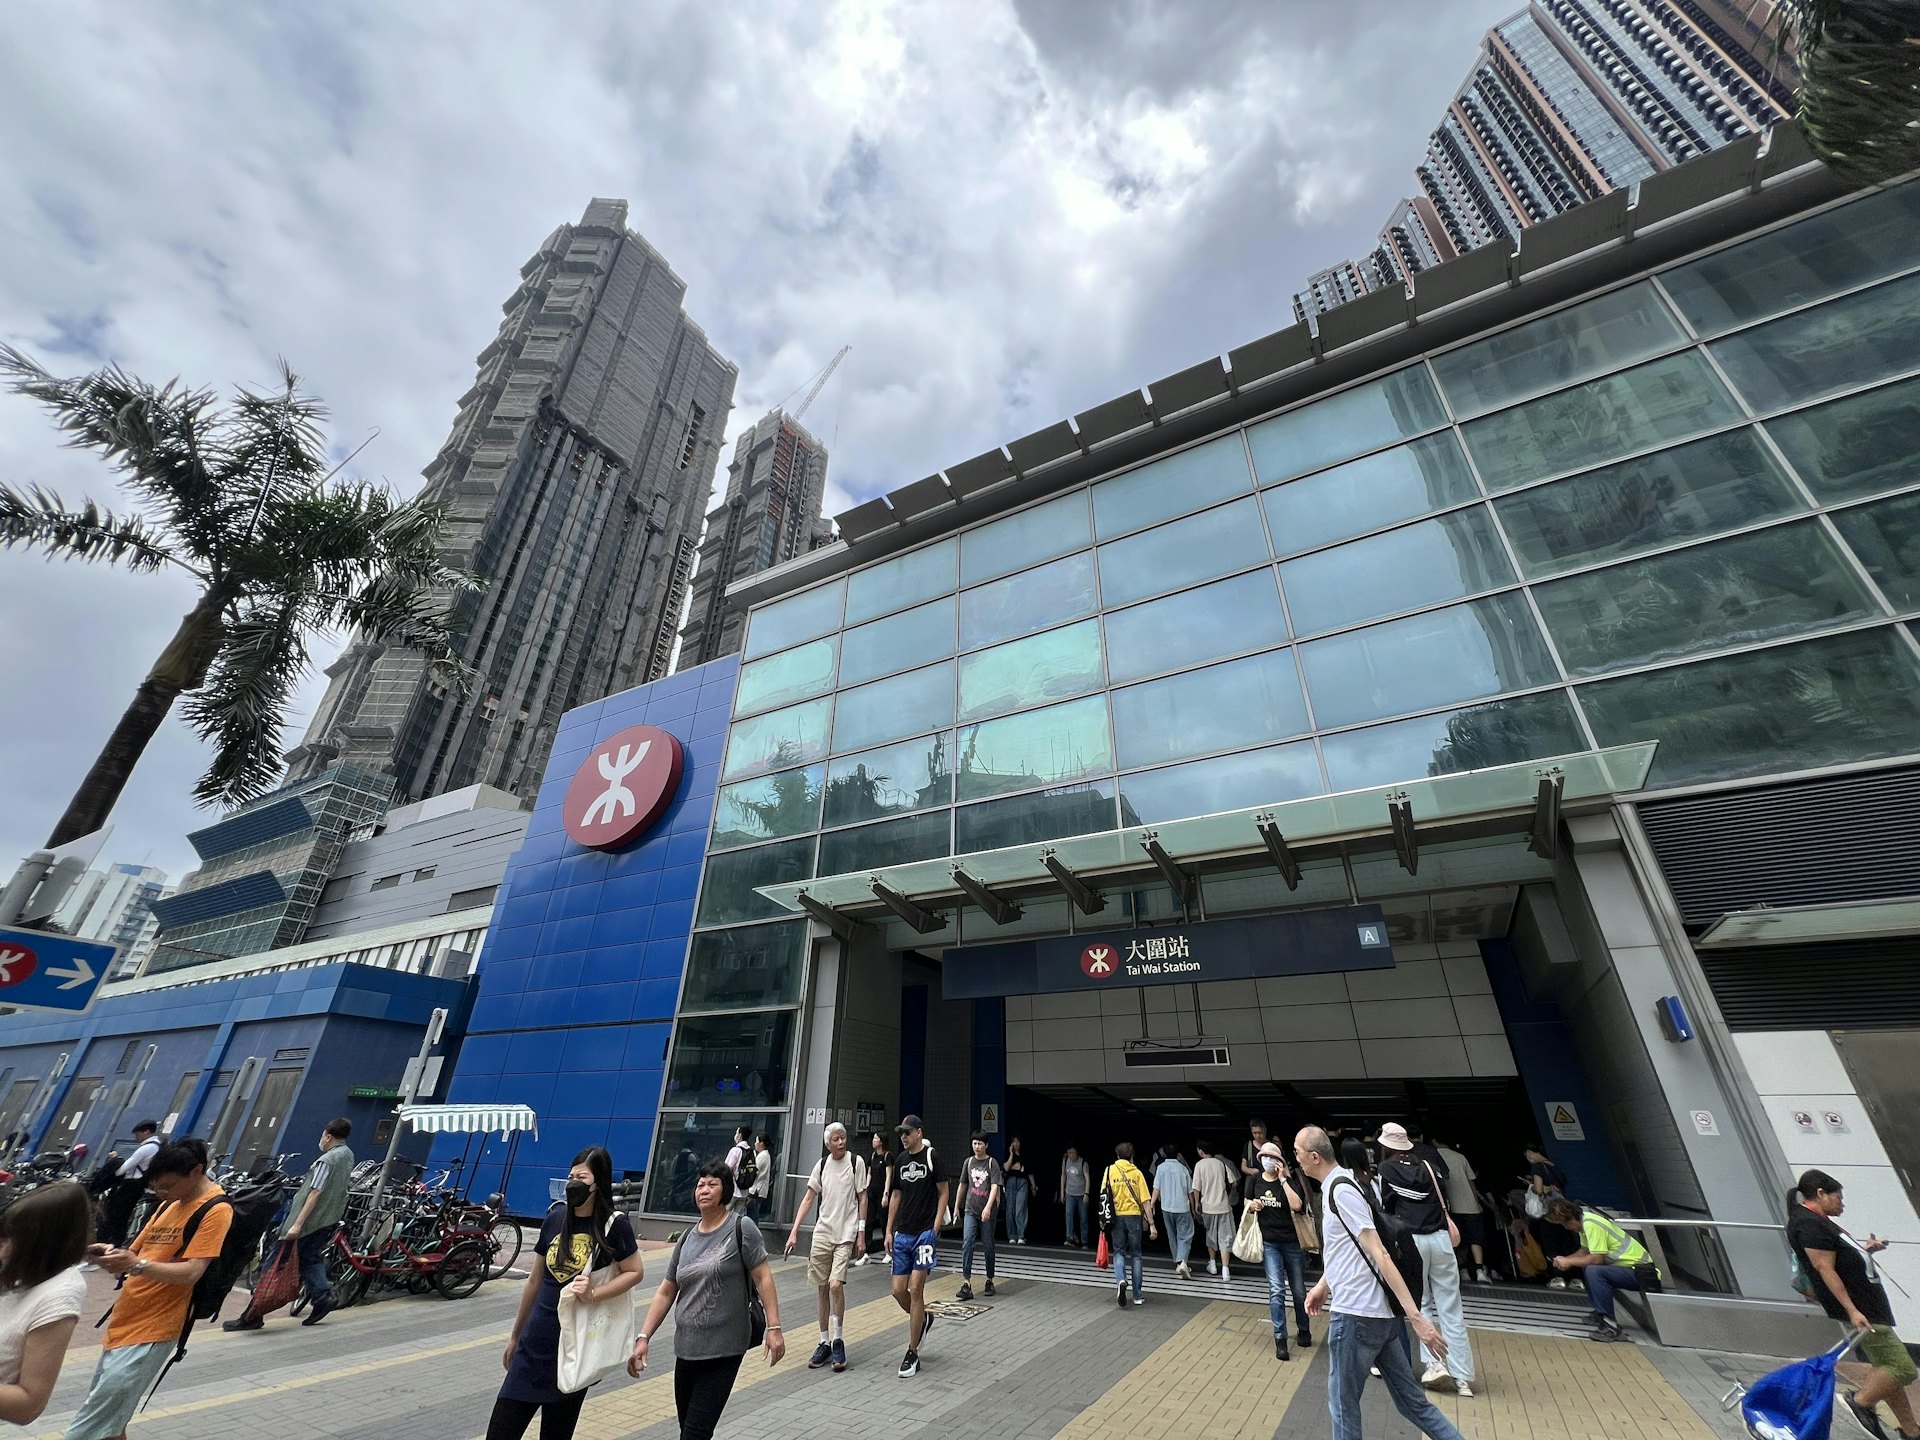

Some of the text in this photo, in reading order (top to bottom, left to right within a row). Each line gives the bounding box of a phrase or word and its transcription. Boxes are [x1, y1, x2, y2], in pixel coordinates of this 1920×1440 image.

[1364, 929, 1375, 942] A
[1125, 935, 1190, 963] 大圍站
[1125, 960, 1201, 976] Tai Wai Station
[916, 1244, 934, 1265] JR
